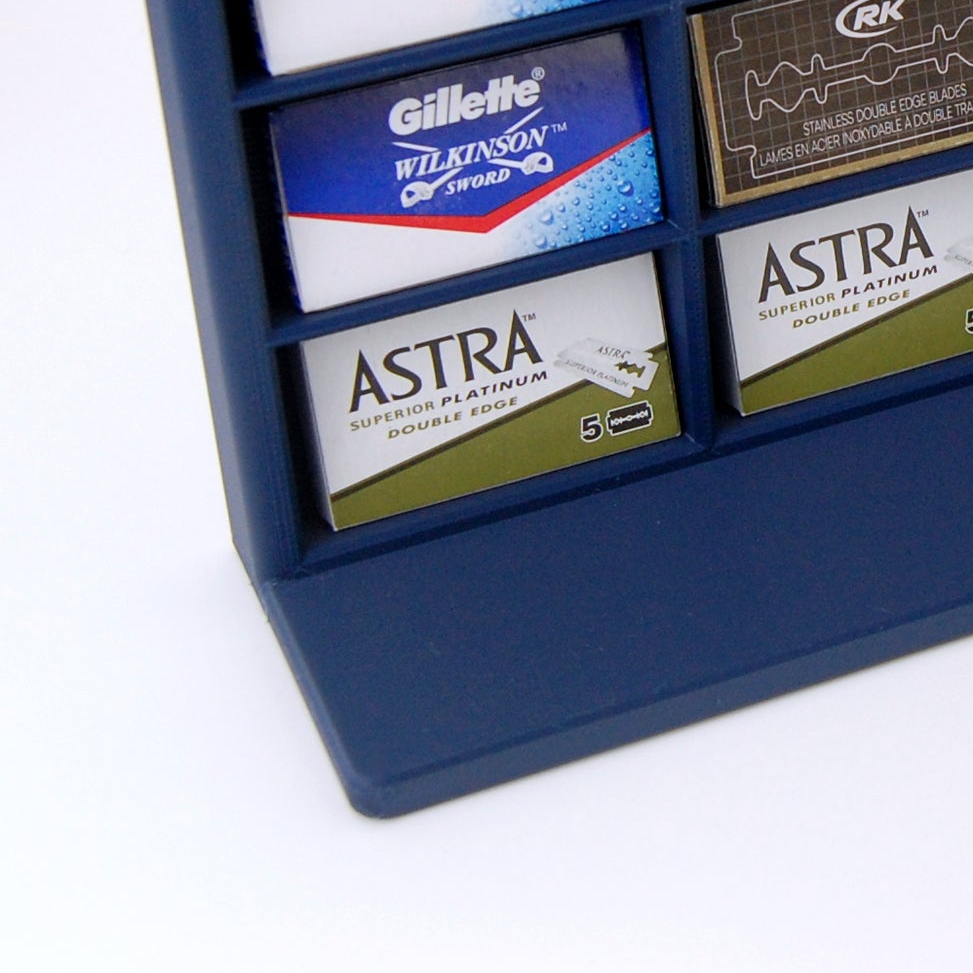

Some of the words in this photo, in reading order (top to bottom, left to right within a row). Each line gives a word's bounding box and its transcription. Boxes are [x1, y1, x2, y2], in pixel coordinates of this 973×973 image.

[760, 147, 793, 167] LAMES
[796, 142, 809, 158] EN
[812, 135, 840, 154] ACIER
[843, 120, 902, 148] INOXYDABLE
[912, 106, 952, 127] DOUBLE
[803, 112, 854, 137] STAINLESS
[857, 101, 896, 124] DOUBLE
[899, 93, 927, 114] EDGE
[930, 84, 967, 106] BLADES
[394, 125, 548, 181] WILKINSON
[446, 168, 510, 195] SWORD
[758, 292, 835, 321] SUPERIOR
[841, 265, 938, 298] PLATINUM
[792, 303, 860, 328] DOUBLE
[867, 289, 911, 308] EDGE
[350, 401, 434, 432] SUPERIOR
[441, 371, 548, 407] PLATINUM
[388, 411, 463, 439] DOUBLE
[470, 397, 518, 417] EDGE
[580, 414, 603, 442] 5
